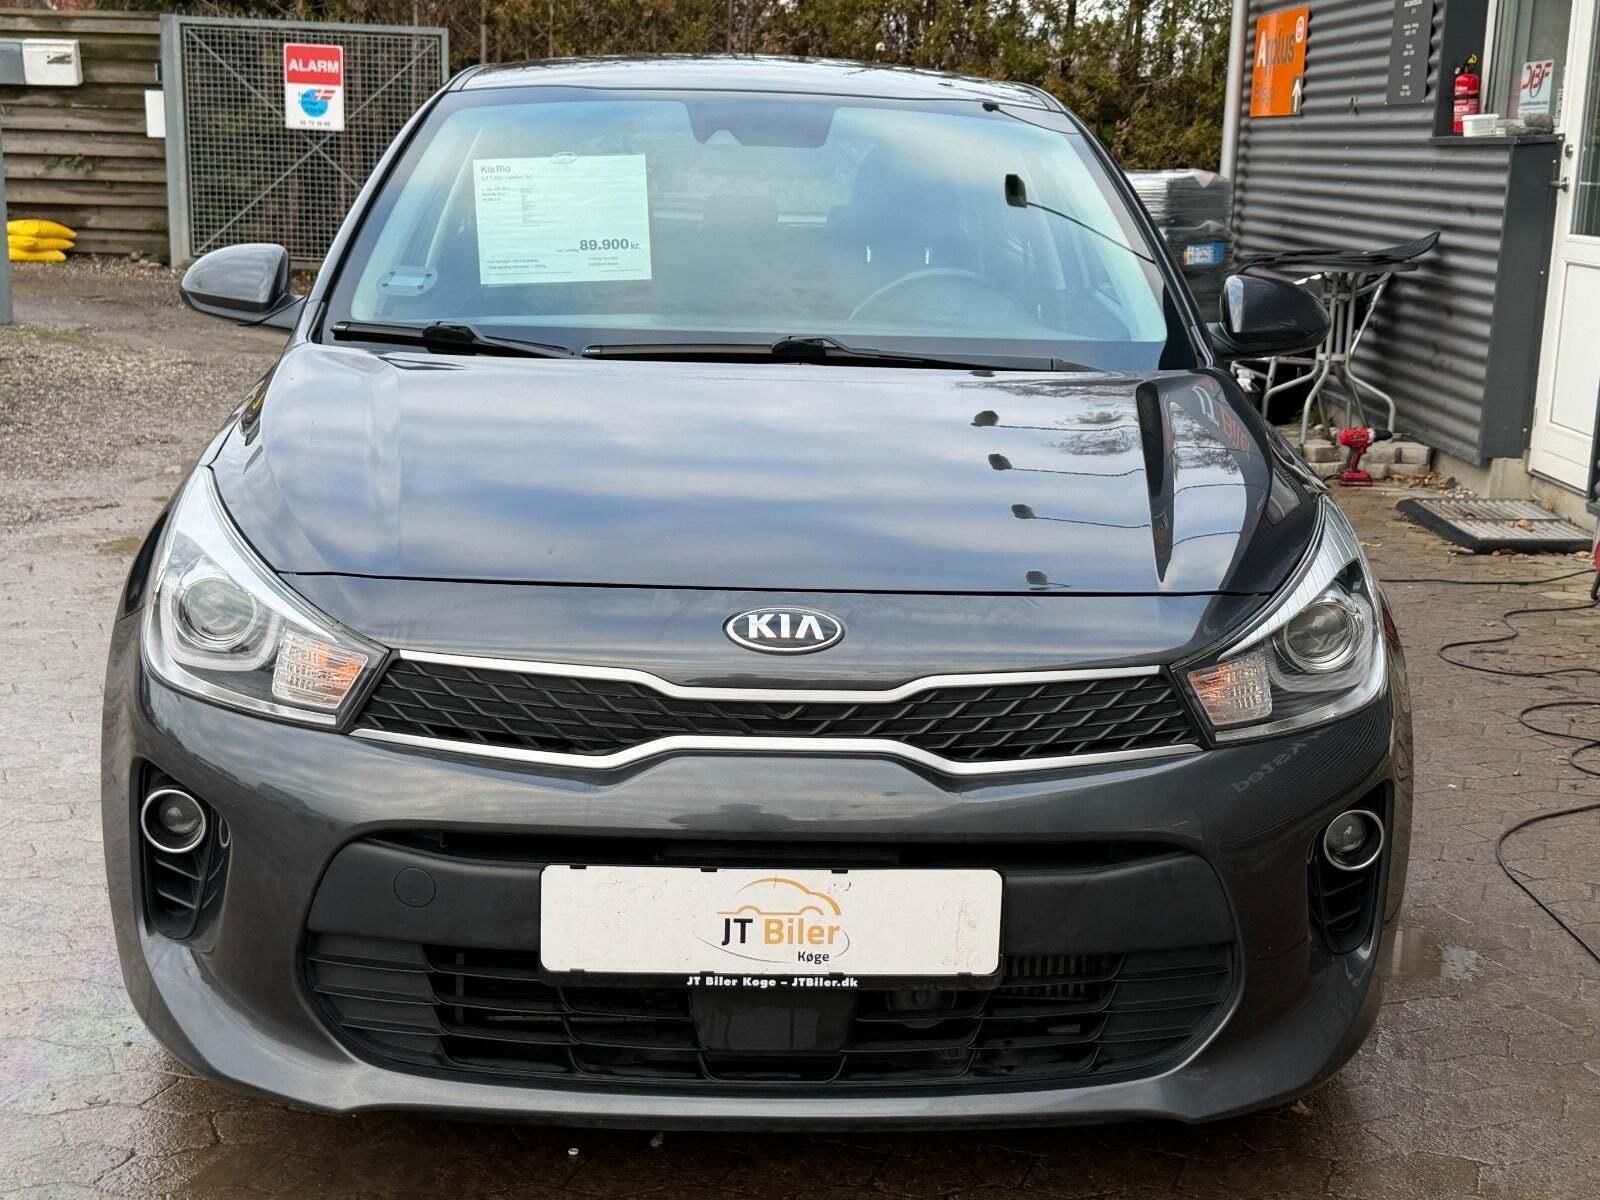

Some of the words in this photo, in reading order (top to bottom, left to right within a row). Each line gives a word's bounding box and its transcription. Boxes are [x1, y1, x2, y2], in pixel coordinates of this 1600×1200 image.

[288, 58, 339, 74] ALARM
[480, 164, 495, 174] Kia
[496, 164, 511, 173] Rio
[579, 238, 630, 252] 89.900
[630, 240, 642, 251] kr.
[747, 613, 825, 641] KIA
[721, 917, 753, 946] JT
[763, 917, 840, 946] Biler
[797, 949, 830, 965] Køge
[686, 976, 701, 986] JT
[705, 976, 738, 987] Biler
[791, 977, 858, 988] JTBiler.dk
